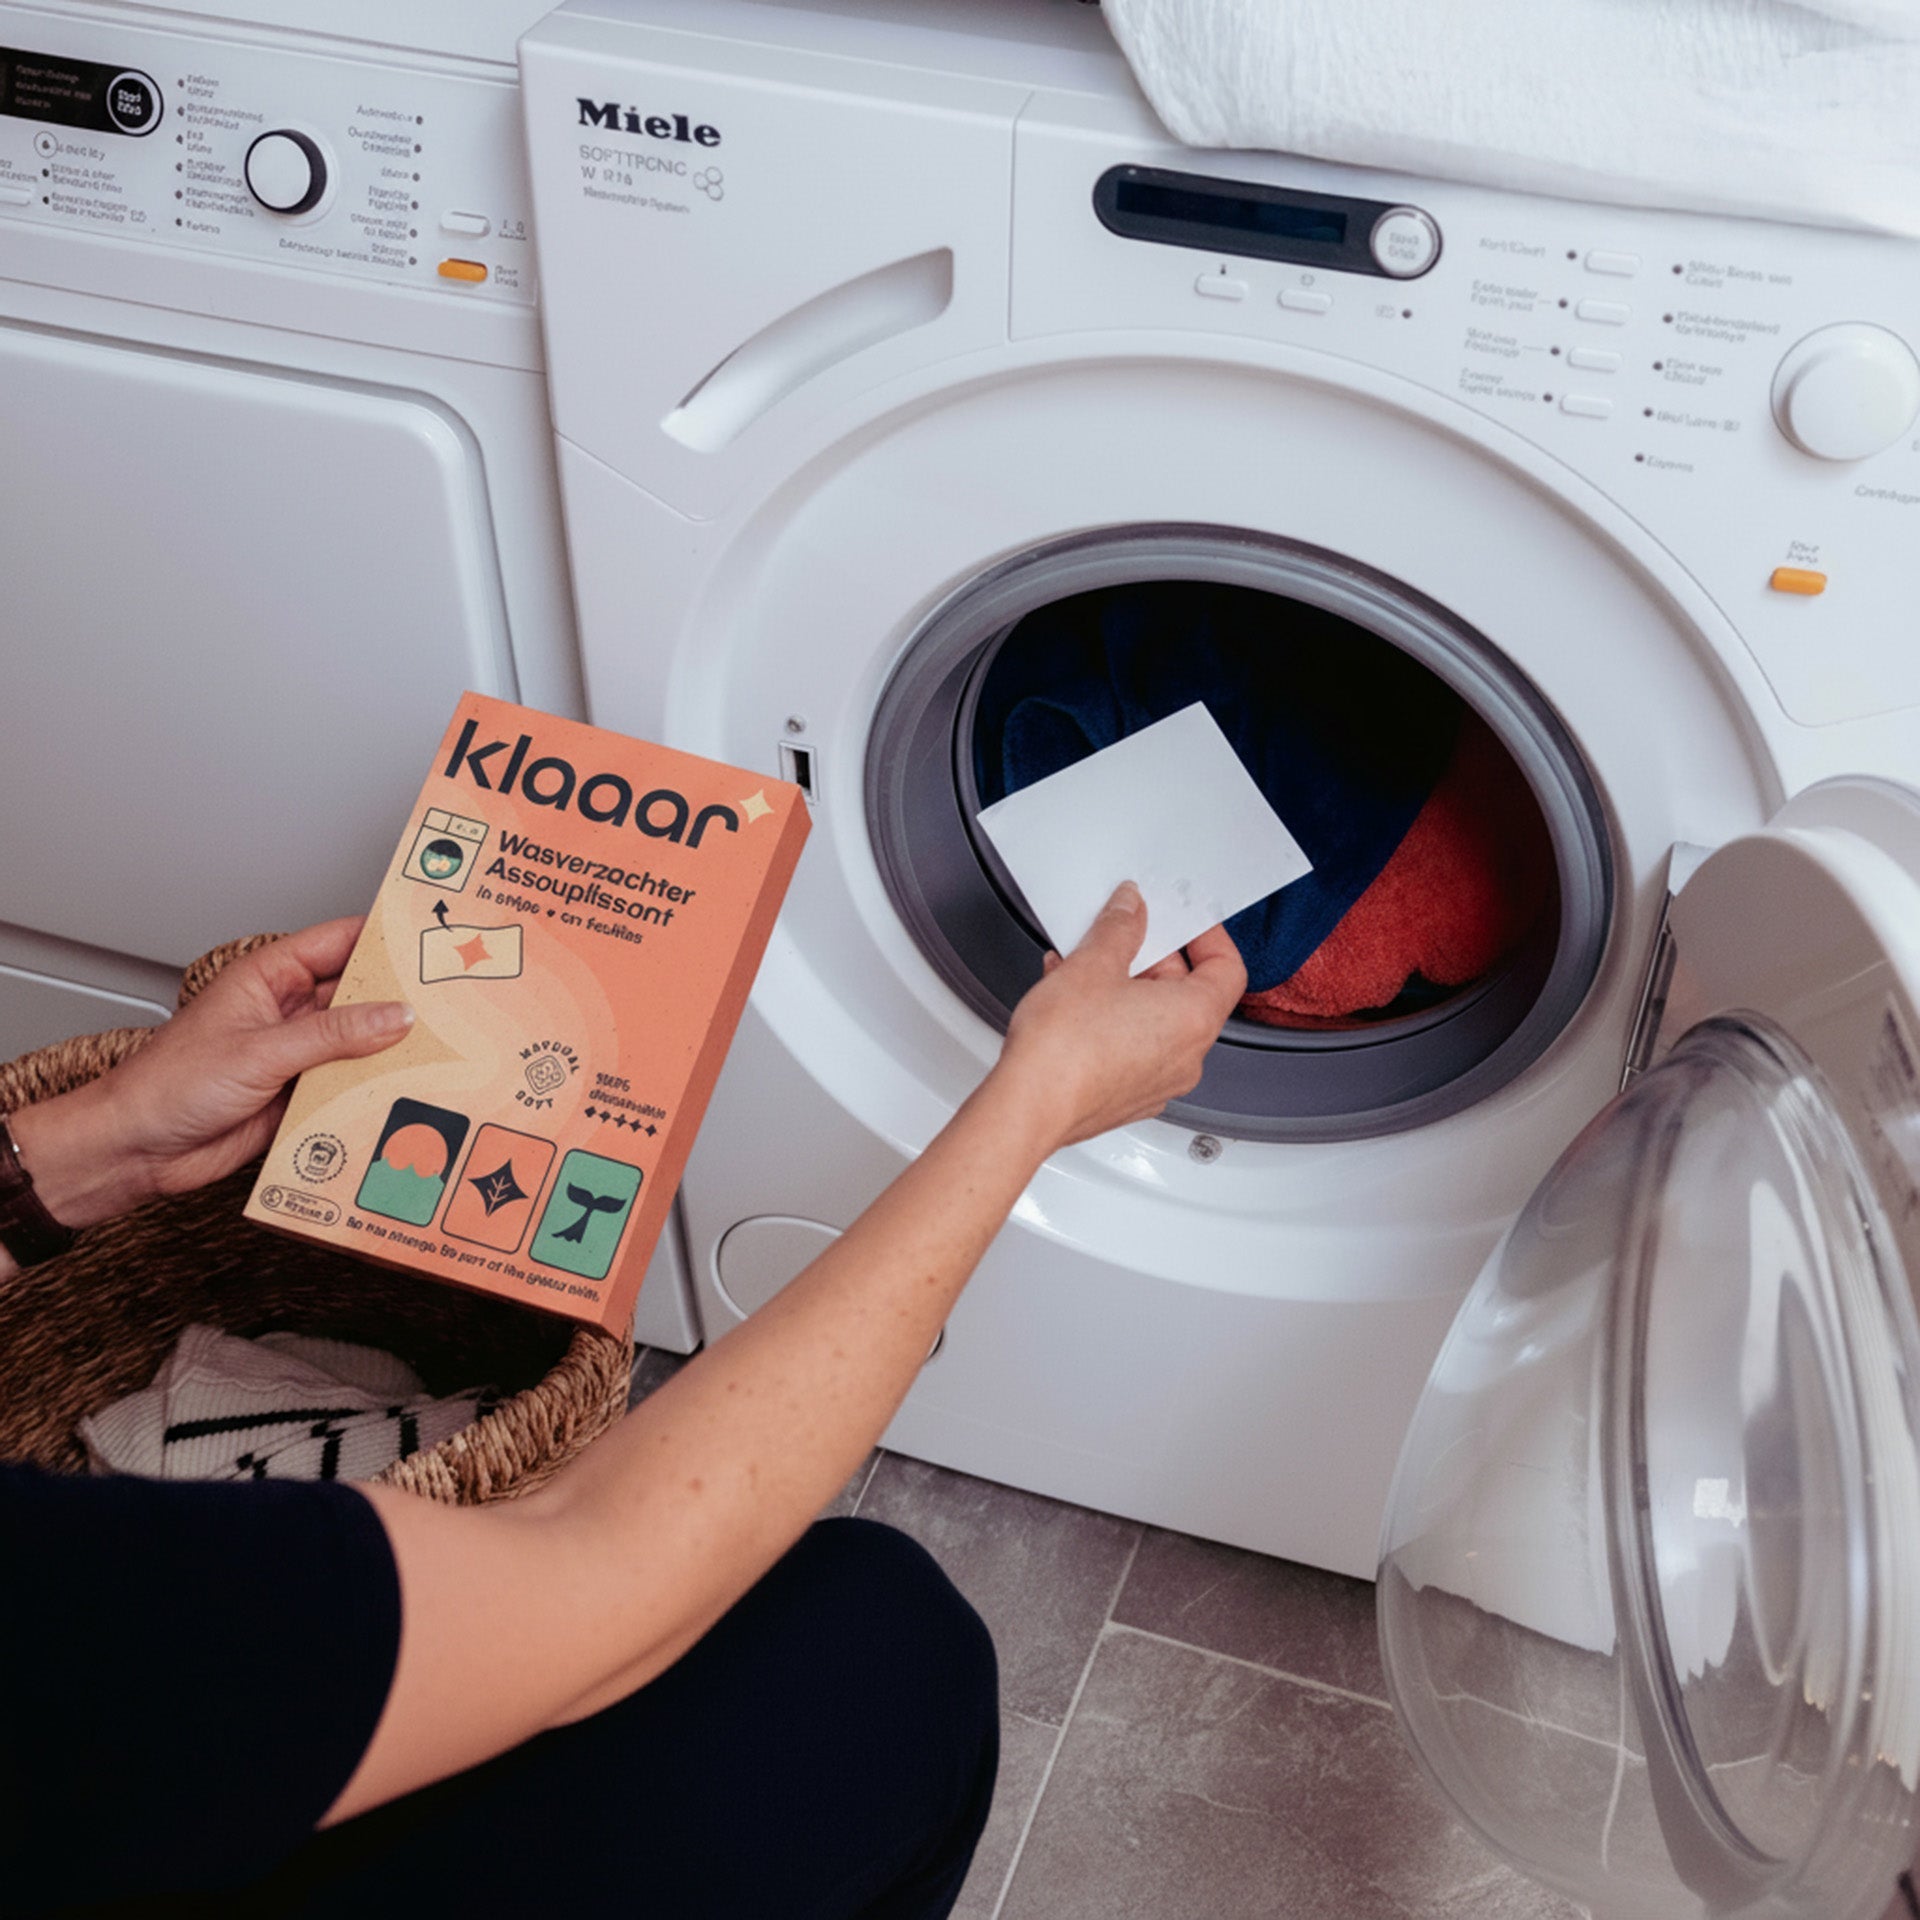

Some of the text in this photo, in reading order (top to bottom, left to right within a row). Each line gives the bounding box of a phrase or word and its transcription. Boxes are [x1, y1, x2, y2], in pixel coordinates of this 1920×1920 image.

[576, 97, 721, 148] Miele
[444, 718, 740, 849] klaaar
[500, 829, 697, 906] Wasverzachter
